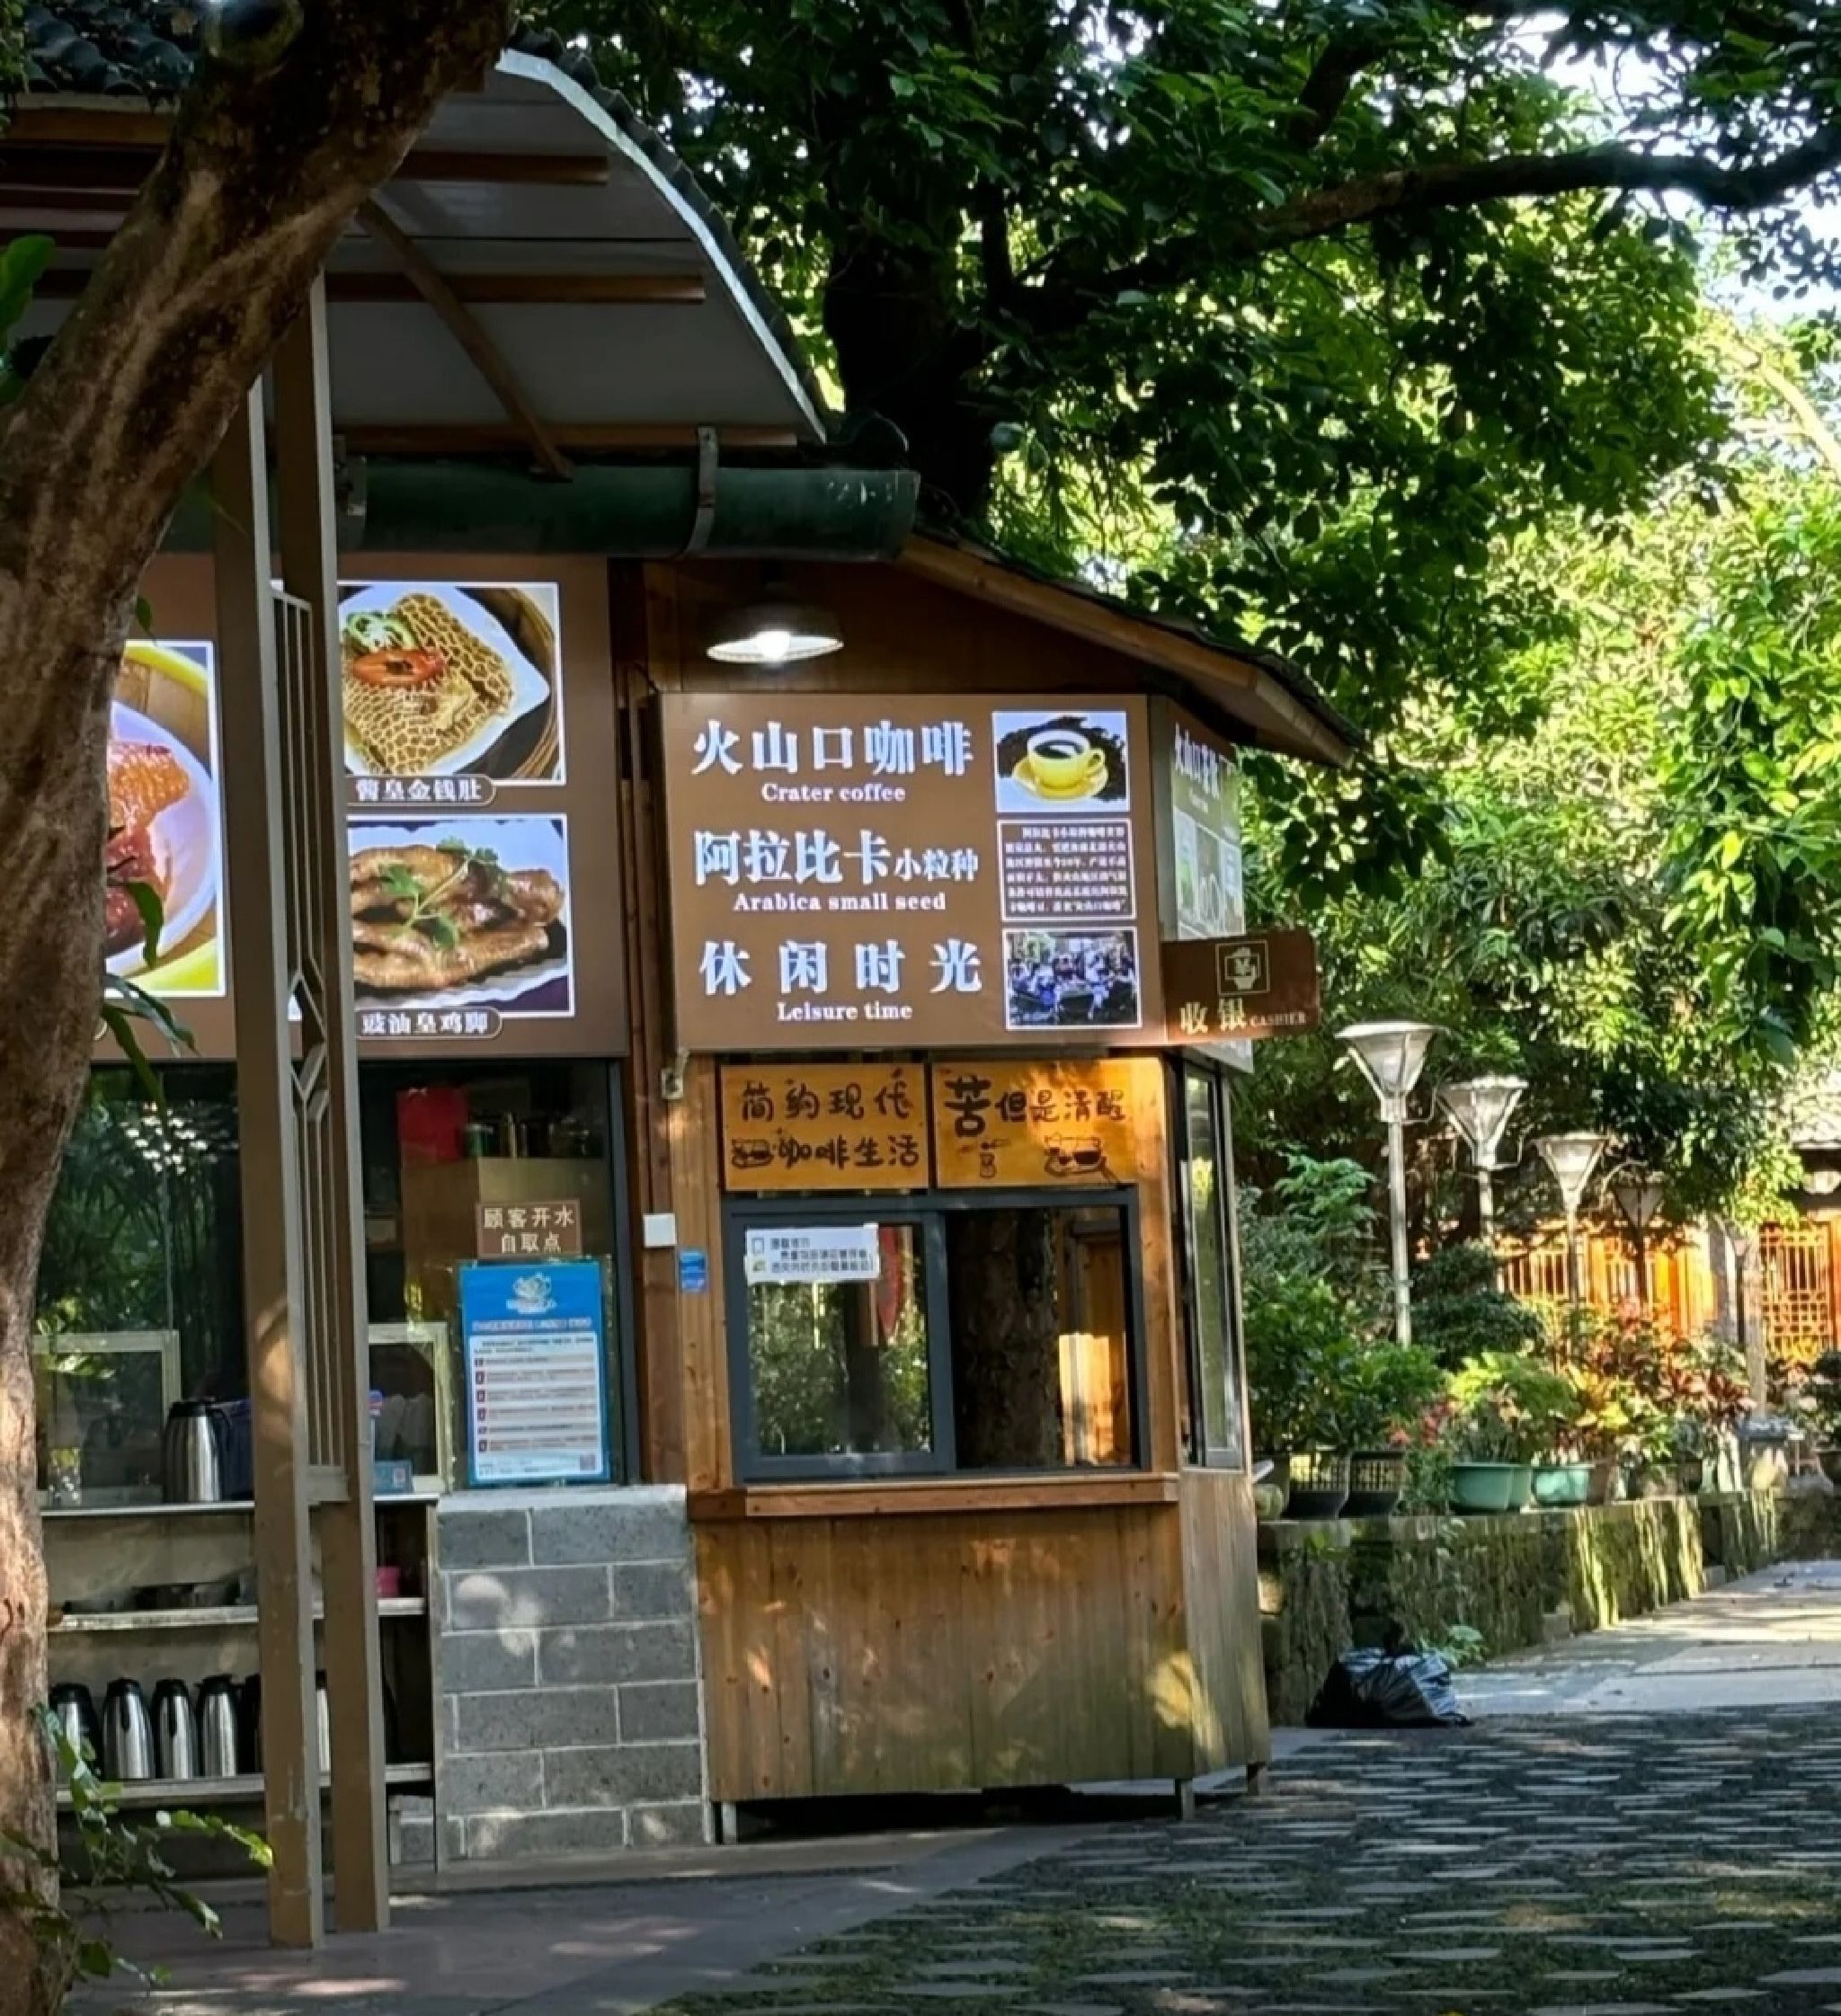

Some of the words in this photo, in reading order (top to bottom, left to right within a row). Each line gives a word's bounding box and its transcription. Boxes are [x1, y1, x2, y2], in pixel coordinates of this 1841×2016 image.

[691, 720, 974, 776] 火山口咖啡
[761, 784, 831, 802] Crater
[840, 784, 905, 802] coffee
[694, 830, 979, 885] 阿拉比卡小粒种
[734, 893, 821, 911] Arabica
[829, 893, 888, 911] small
[896, 893, 946, 911] seed
[699, 939, 982, 995] 休闲时光
[778, 1002, 858, 1021] Leisure
[864, 1002, 912, 1021] time
[1179, 997, 1246, 1035] 收银
[1250, 1011, 1307, 1027] CASHIER
[742, 1078, 912, 1123] 简约现代
[945, 1075, 1125, 1138] 苦但是清醒
[778, 1134, 920, 1169] 咖啡生活
[484, 1205, 575, 1229] 顾客开水
[501, 1231, 562, 1254] 自取点
